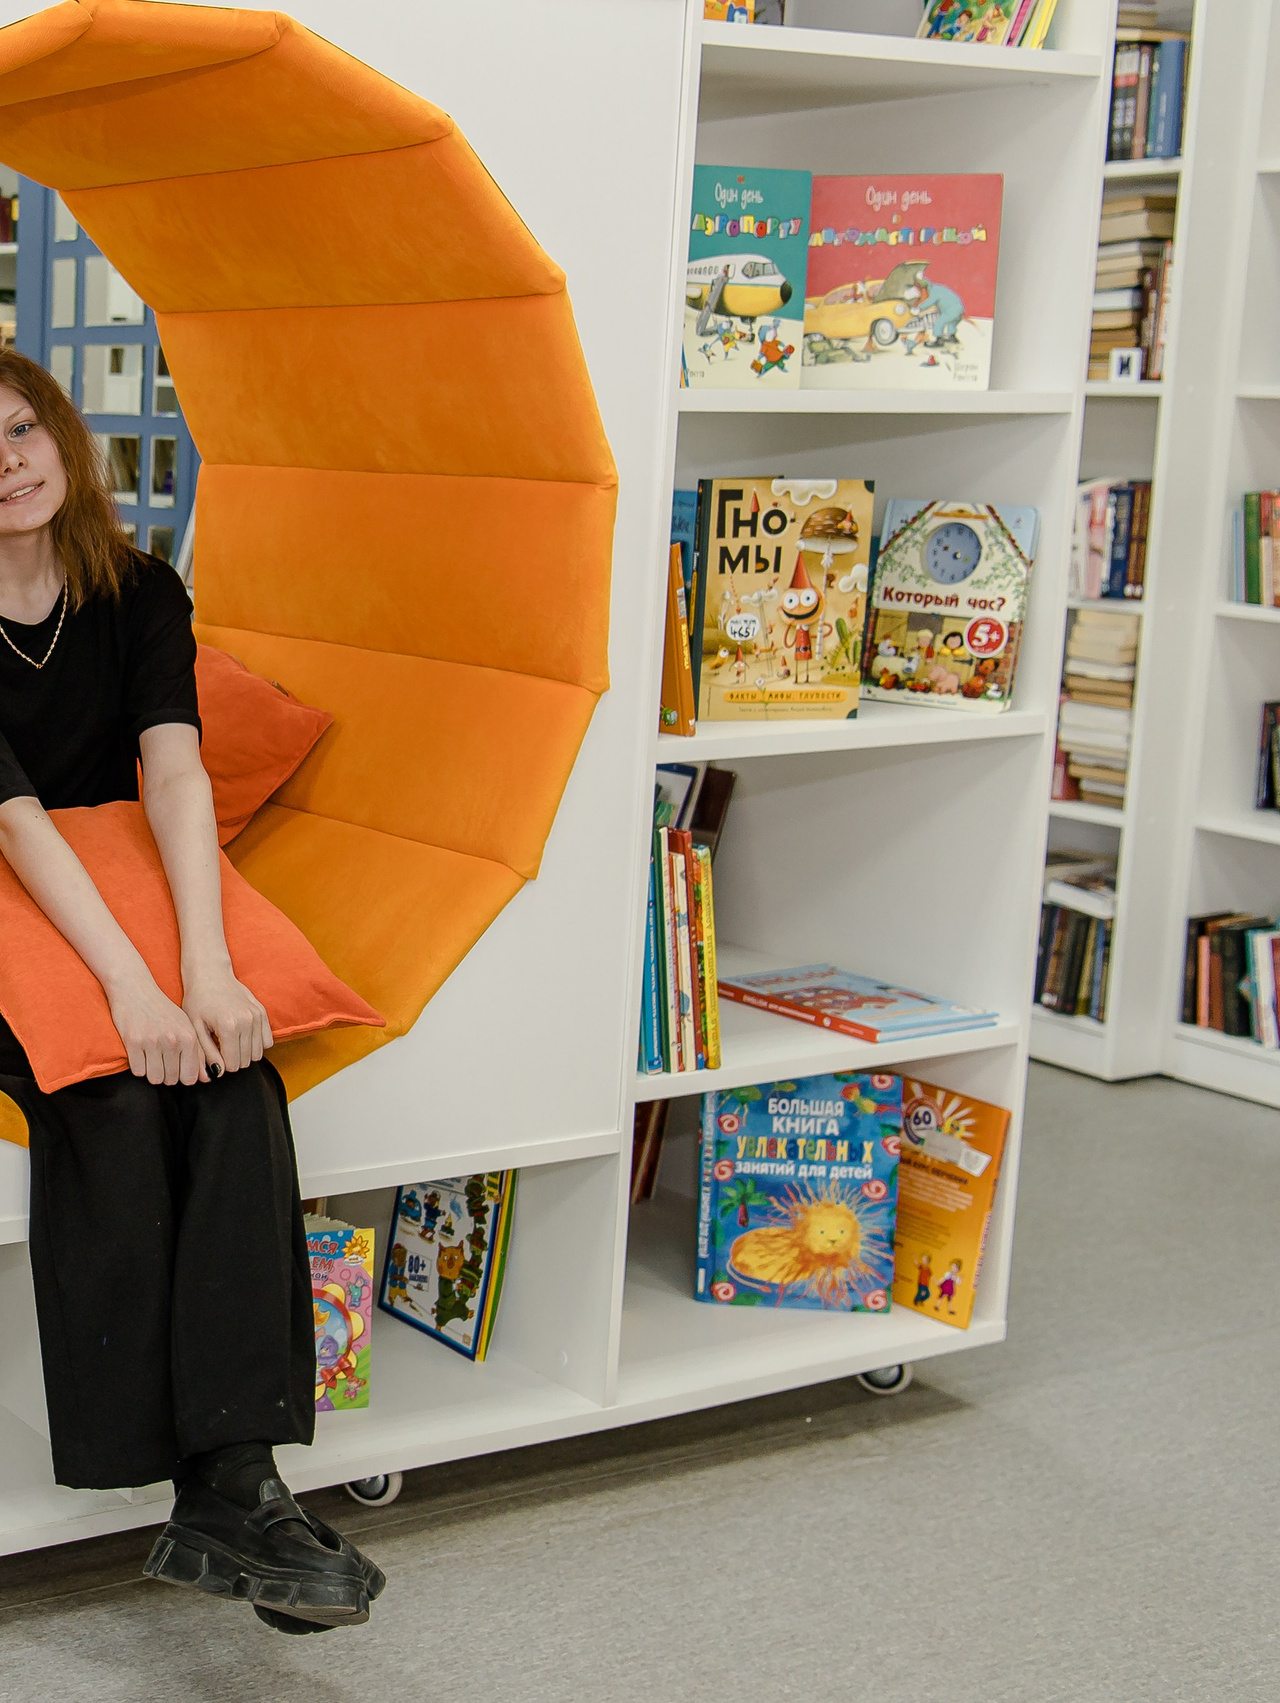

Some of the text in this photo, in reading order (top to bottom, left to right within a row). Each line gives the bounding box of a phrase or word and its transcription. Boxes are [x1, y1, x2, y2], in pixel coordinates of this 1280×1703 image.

[714, 182, 764, 210] Один день
[866, 186, 932, 212] Один день
[692, 212, 802, 238] АЭРОПОРТУ
[883, 586, 1006, 612] Который час?
[730, 626, 756, 638] 4651
[972, 624, 1000, 647] 5+
[768, 1098, 844, 1118] БОЛЬШАЯ
[913, 1110, 932, 1126] 60
[772, 1117, 840, 1136] КНИГА
[734, 1160, 873, 1180] занятий для детей
[408, 1254, 426, 1274] 80+
